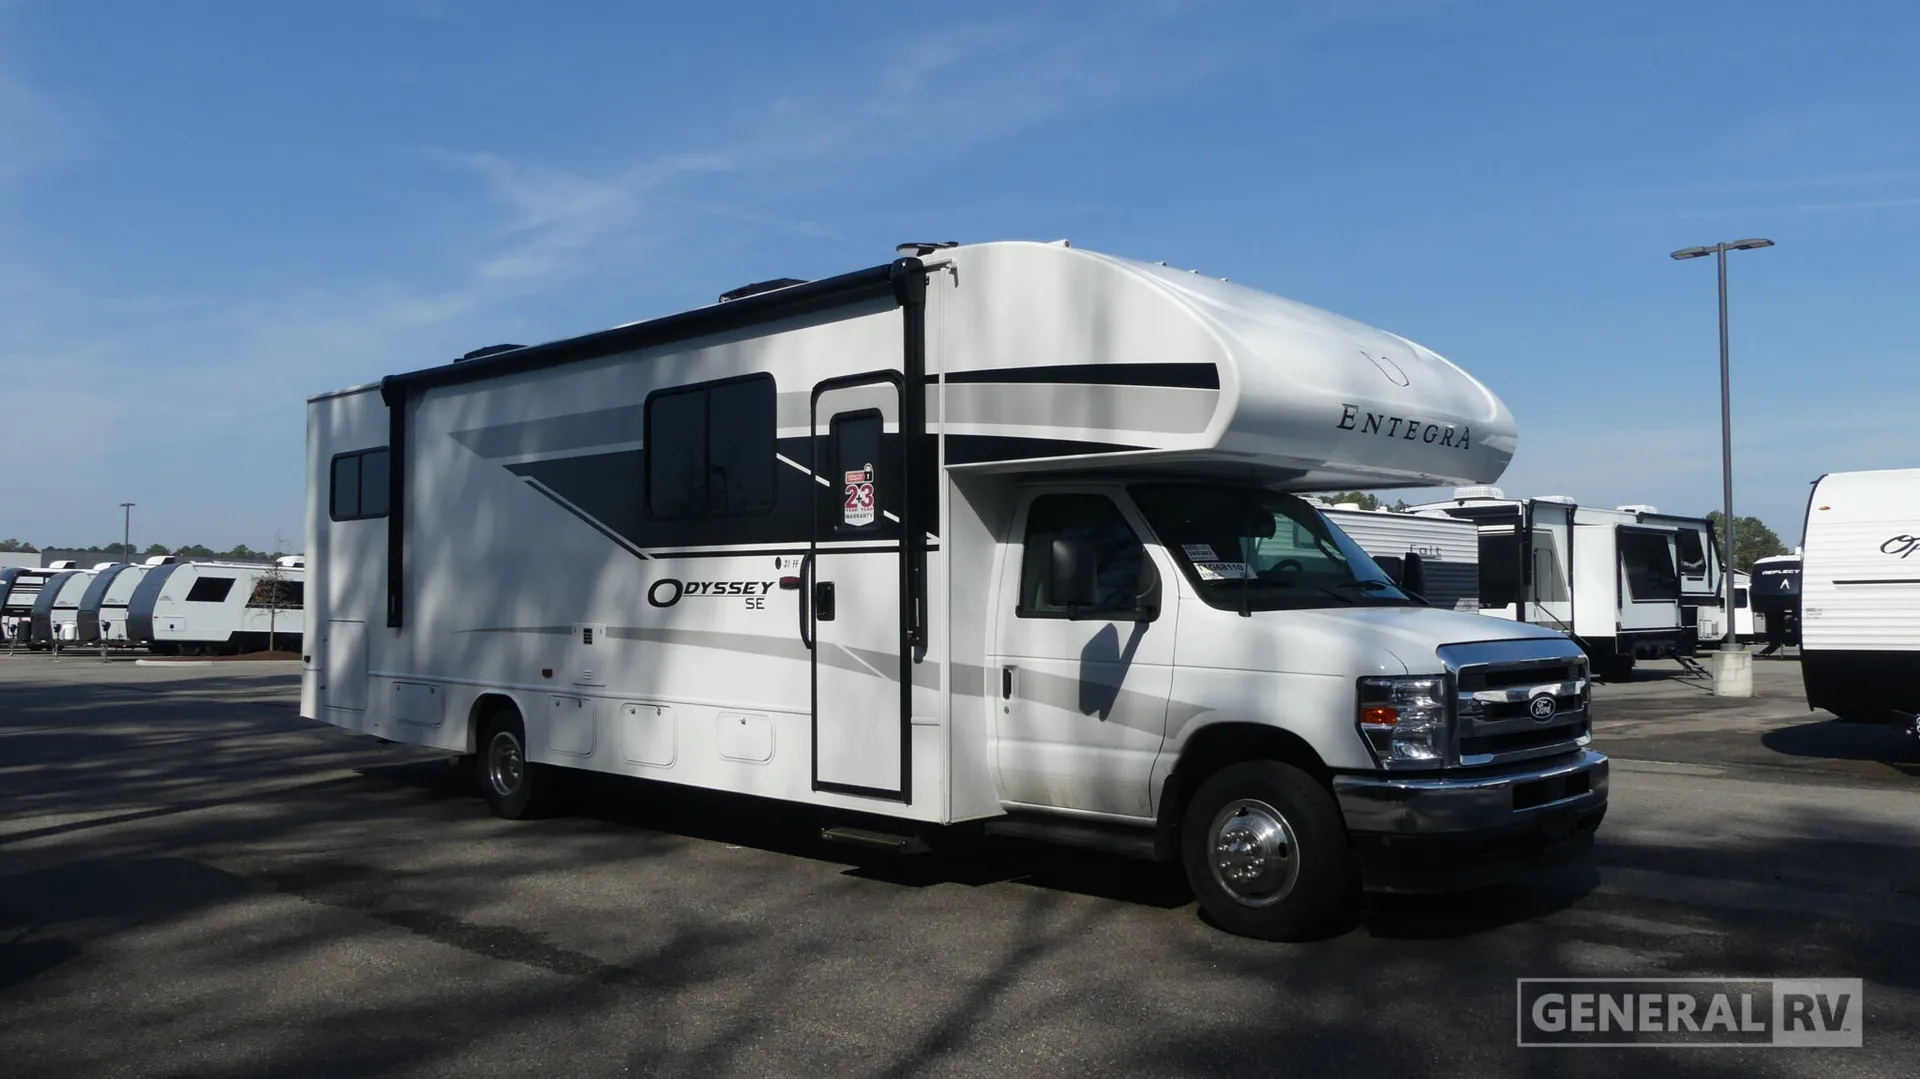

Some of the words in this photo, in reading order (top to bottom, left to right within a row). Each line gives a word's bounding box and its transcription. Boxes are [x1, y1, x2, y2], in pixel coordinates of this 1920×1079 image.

[1336, 403, 1471, 450] ENTEGRA
[647, 578, 776, 608] ODYSSEY
[745, 597, 765, 610] SE
[1535, 699, 1551, 715] Ford
